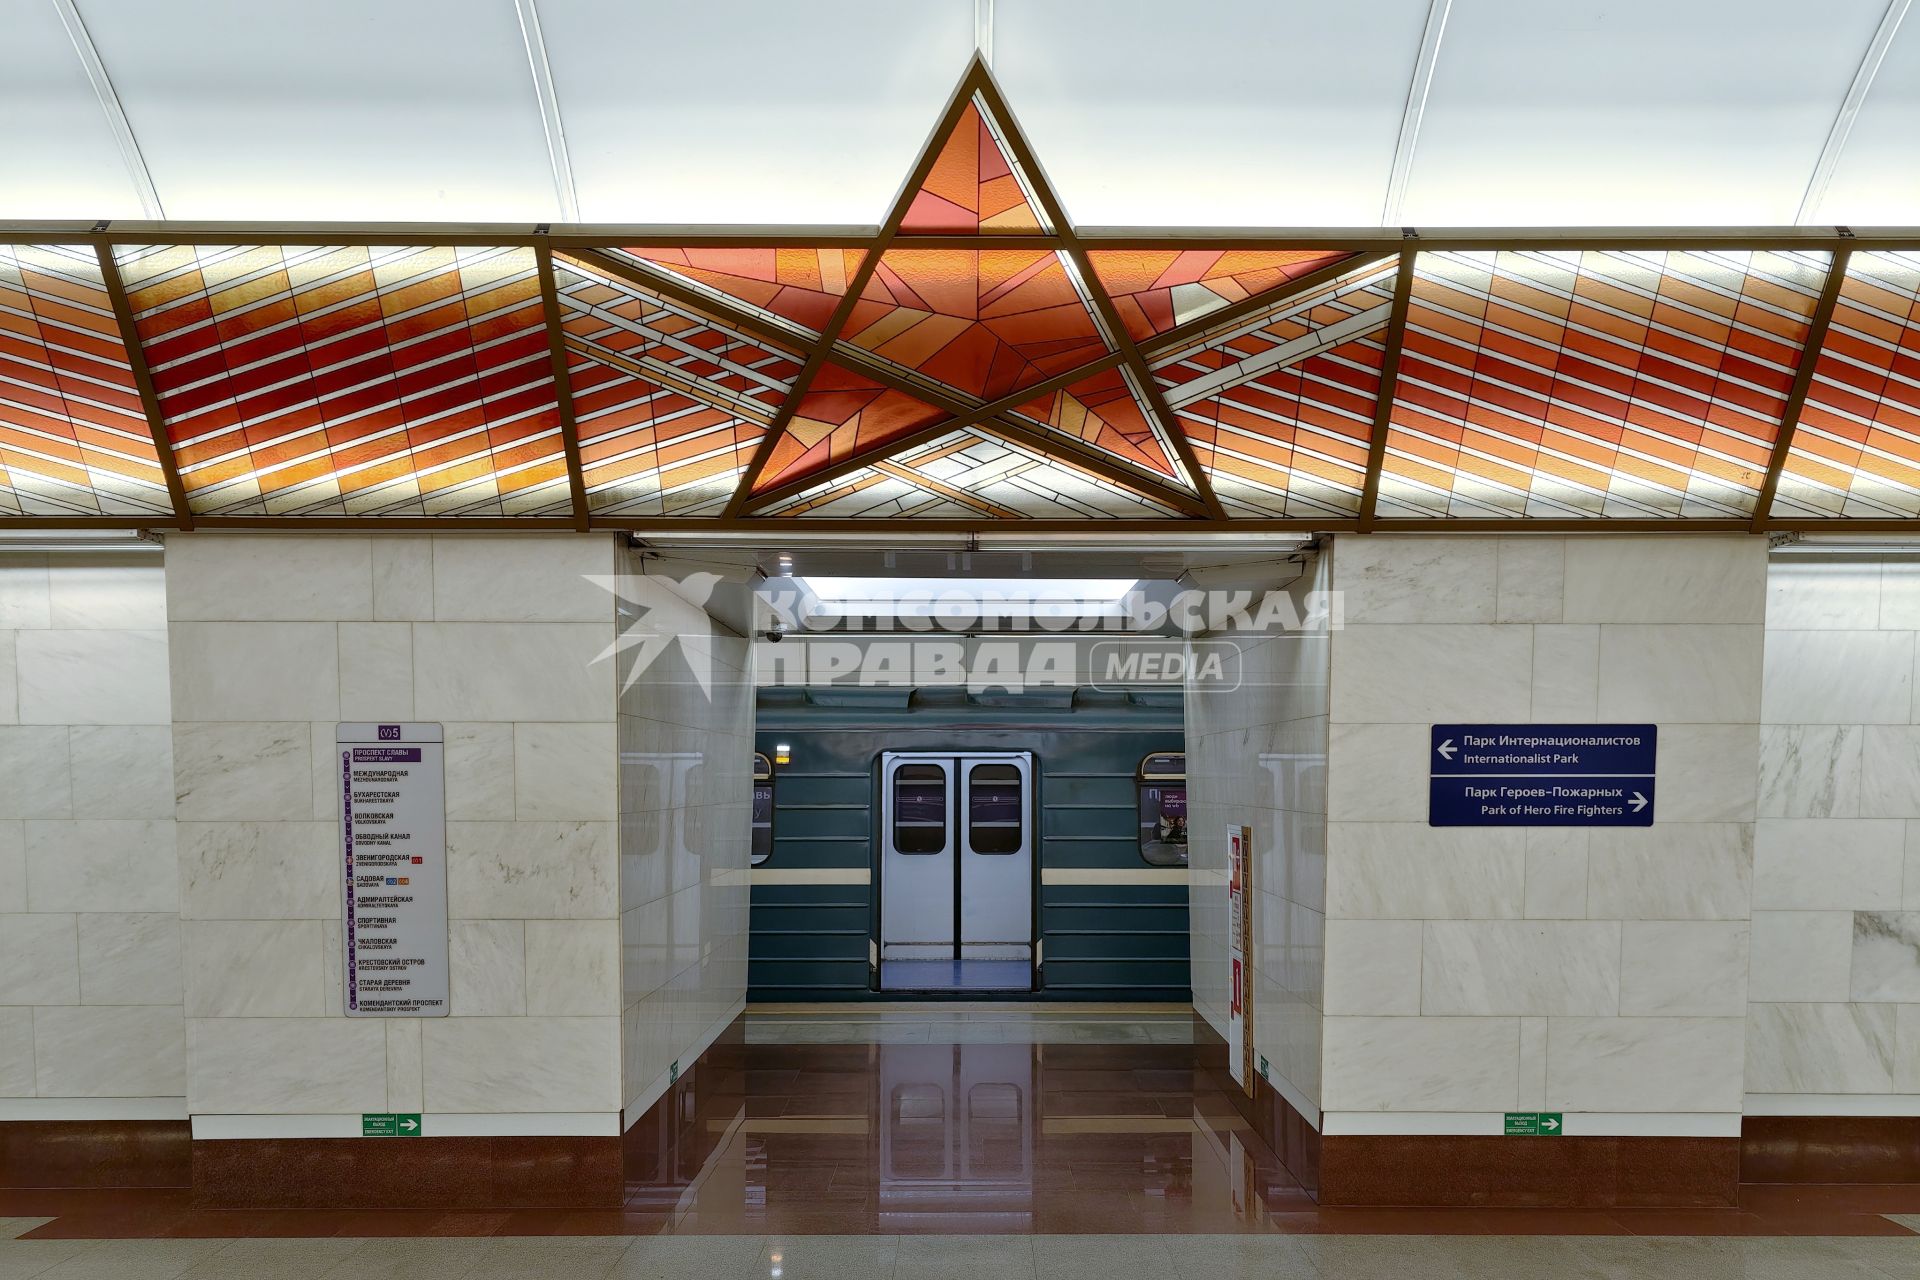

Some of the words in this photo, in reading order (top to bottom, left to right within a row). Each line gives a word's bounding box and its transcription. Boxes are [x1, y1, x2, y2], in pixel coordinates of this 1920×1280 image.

[392, 728, 399, 738] 5
[1464, 736, 1497, 747] Парк
[1499, 736, 1641, 747] Интернационалистов
[1464, 754, 1551, 764] Internationalist
[1553, 754, 1579, 764] Park
[1465, 787, 1497, 798] Парк
[1500, 787, 1623, 798] Героев-Пожарных
[1482, 805, 1507, 815] Park
[1509, 805, 1522, 815] of
[1524, 805, 1551, 815] Hero
[1554, 805, 1575, 815] Fire
[1577, 805, 1623, 817] Fighters
[358, 958, 401, 966] КРЕСТОВСКИЙ
